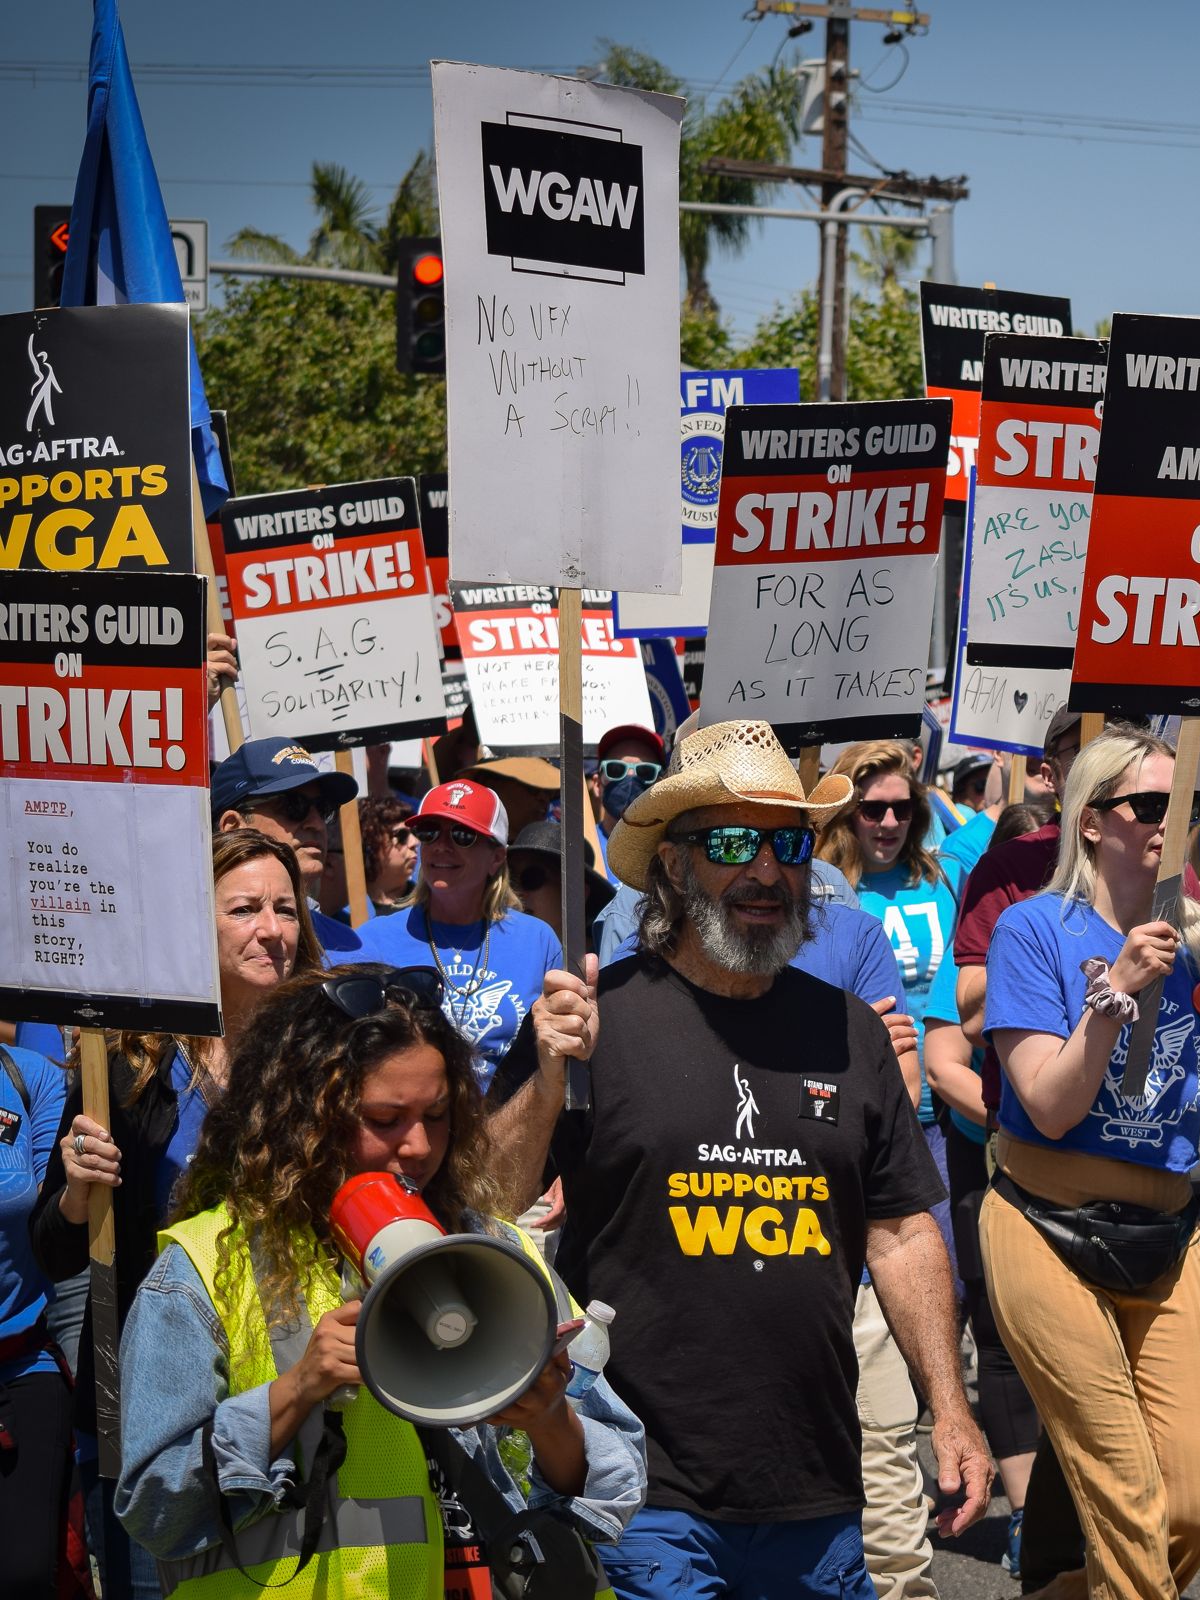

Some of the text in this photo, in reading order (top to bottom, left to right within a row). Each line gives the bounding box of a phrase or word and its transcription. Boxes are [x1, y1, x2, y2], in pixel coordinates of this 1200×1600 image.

[489, 164, 638, 230] WGAW
[477, 294, 571, 345] NO VFX
[929, 304, 1064, 337] WRITERS GUILD
[681, 377, 744, 408] FM
[1000, 357, 1107, 394] WRITER
[505, 403, 526, 438] A
[741, 427, 861, 460] WRITERS
[864, 424, 937, 456] GUILD
[0, 465, 168, 508] PPORTS
[827, 465, 852, 484] ON
[234, 504, 337, 540] WRITERS
[339, 496, 405, 527] GUILD
[732, 482, 930, 553] STRIKE!
[983, 508, 1039, 545] ARE
[312, 532, 335, 550] ON
[242, 541, 415, 609] STRIKE!
[1005, 540, 1087, 580] ZASL
[461, 586, 553, 605] WRITERS
[757, 569, 894, 609] FOR AS
[0, 603, 184, 645] ITERS GUILD
[531, 603, 551, 615] ON
[765, 615, 870, 663] LONG
[54, 652, 83, 678] ON
[477, 660, 560, 675] NOT HER
[262, 651, 422, 718] SOLIDARITY!
[728, 668, 923, 703] AS IT TAKES
[963, 668, 1008, 724] AFM
[0, 685, 186, 771] TRIKE!
[25, 800, 74, 817] AMPTP,
[27, 841, 78, 856] You do
[29, 861, 88, 875] realize
[30, 879, 115, 894] you're the
[31, 897, 116, 913] villain in
[32, 914, 65, 928] this
[34, 932, 83, 949] story,
[35, 951, 85, 966] RIGHT?
[447, 964, 473, 976] ILD
[1120, 1126, 1150, 1138] WEST
[668, 1172, 830, 1201] SUPPORTS
[668, 1205, 832, 1256] WGA
